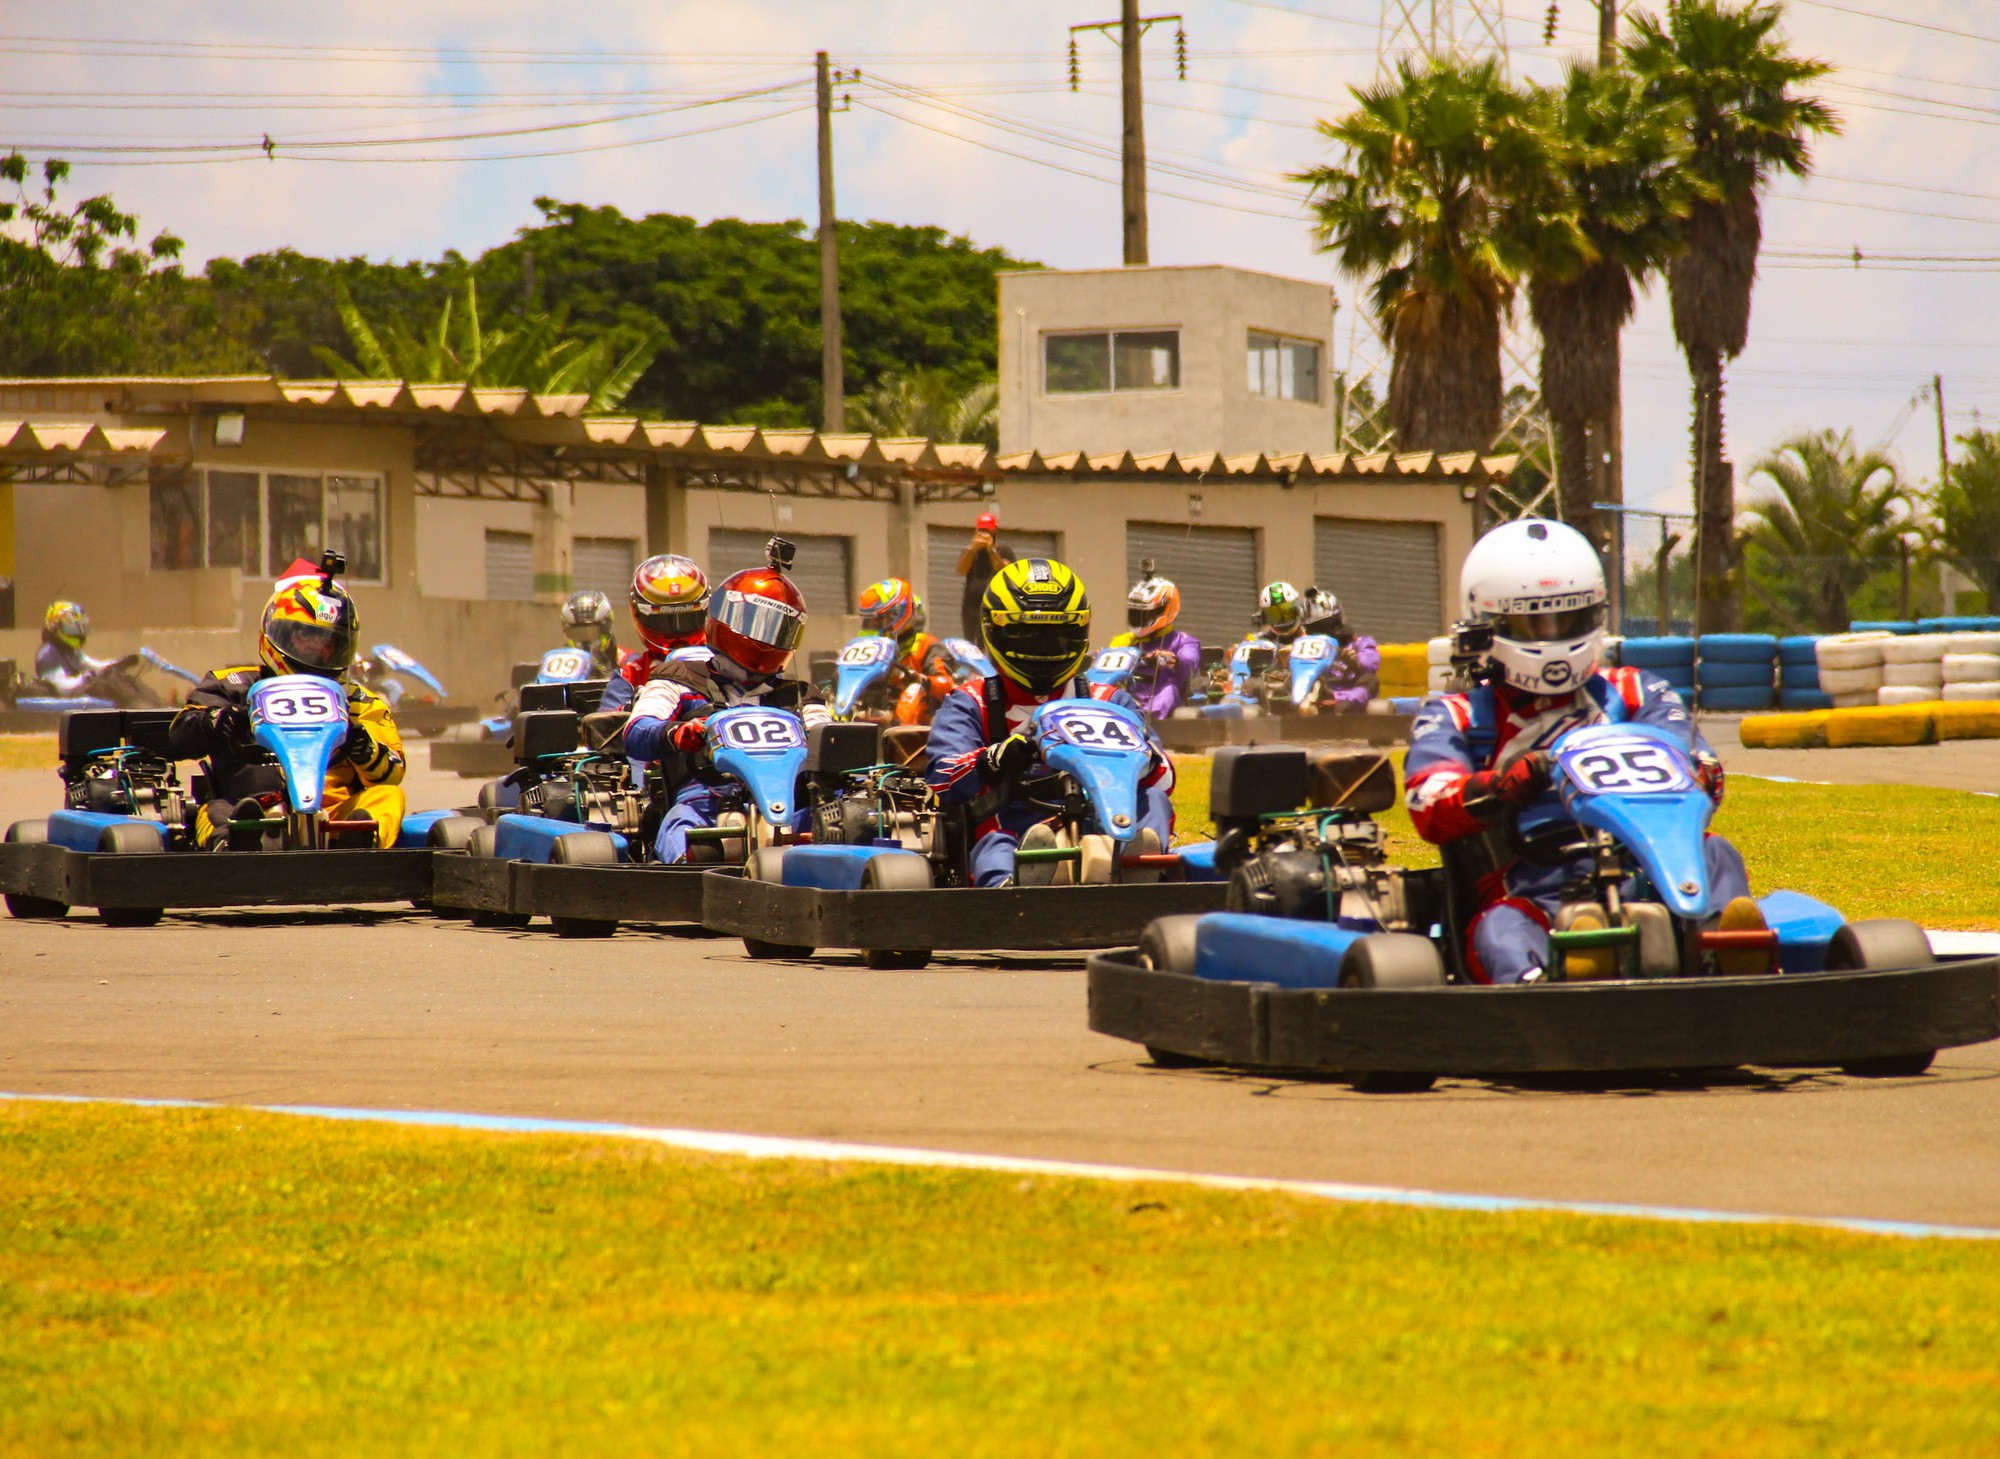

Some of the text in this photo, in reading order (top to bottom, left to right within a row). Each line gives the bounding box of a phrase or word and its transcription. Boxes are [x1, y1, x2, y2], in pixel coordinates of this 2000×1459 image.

[1028, 583, 1058, 593] SHOEI
[843, 647, 874, 662] 05
[1297, 641, 1323, 655] 15
[547, 657, 579, 675] 09
[1102, 656, 1125, 667] 11
[271, 696, 329, 717] 35
[730, 720, 792, 744] 02
[1065, 720, 1136, 746] 24
[1579, 750, 1672, 788] 25
